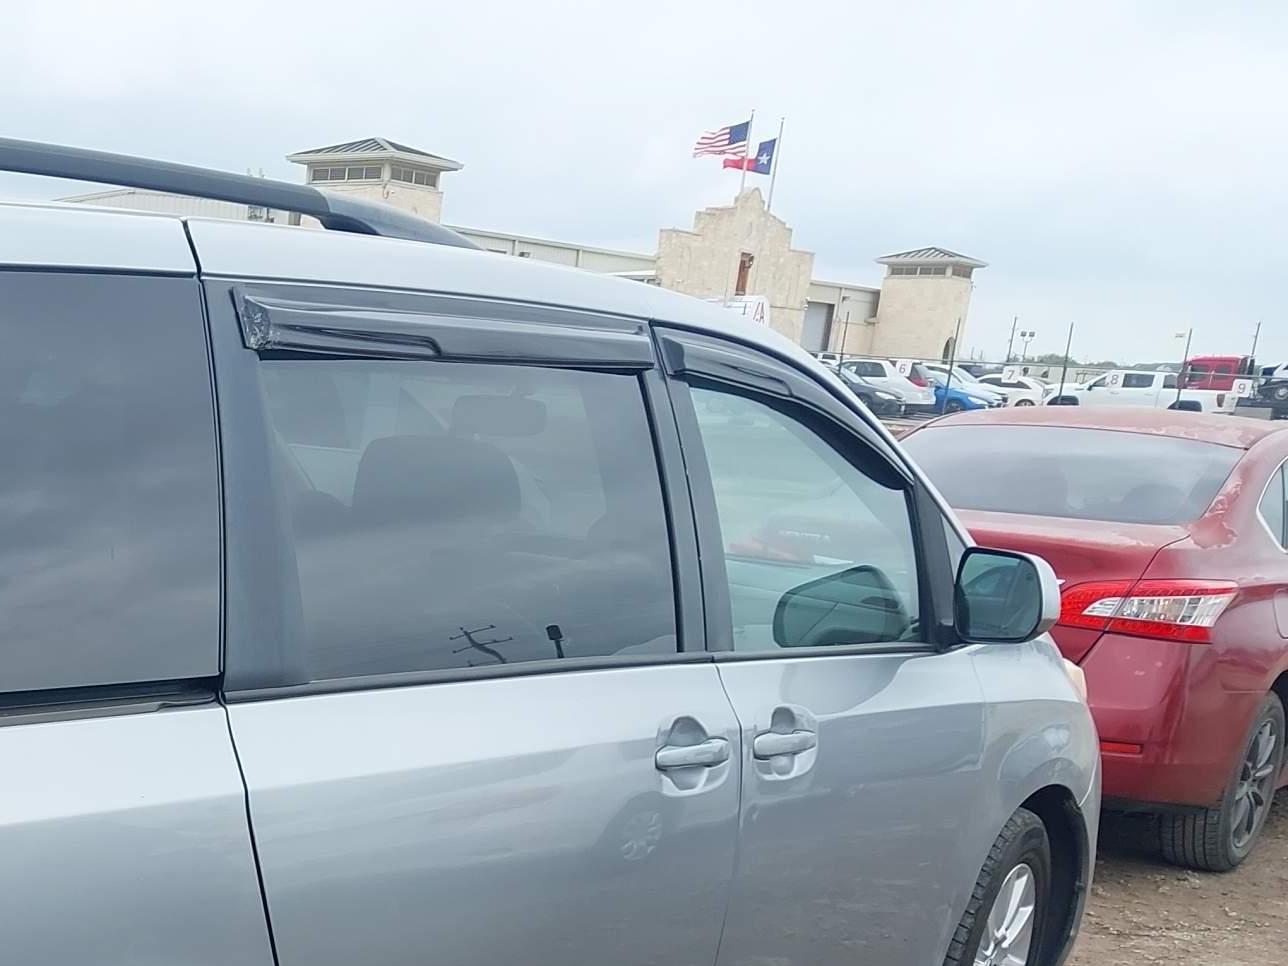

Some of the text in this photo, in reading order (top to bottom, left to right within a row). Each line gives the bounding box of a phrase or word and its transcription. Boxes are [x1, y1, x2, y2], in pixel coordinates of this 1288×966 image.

[899, 363, 906, 374] 6
[1007, 369, 1016, 380] 7
[1110, 374, 1119, 385] 8
[1237, 383, 1246, 393] 9
